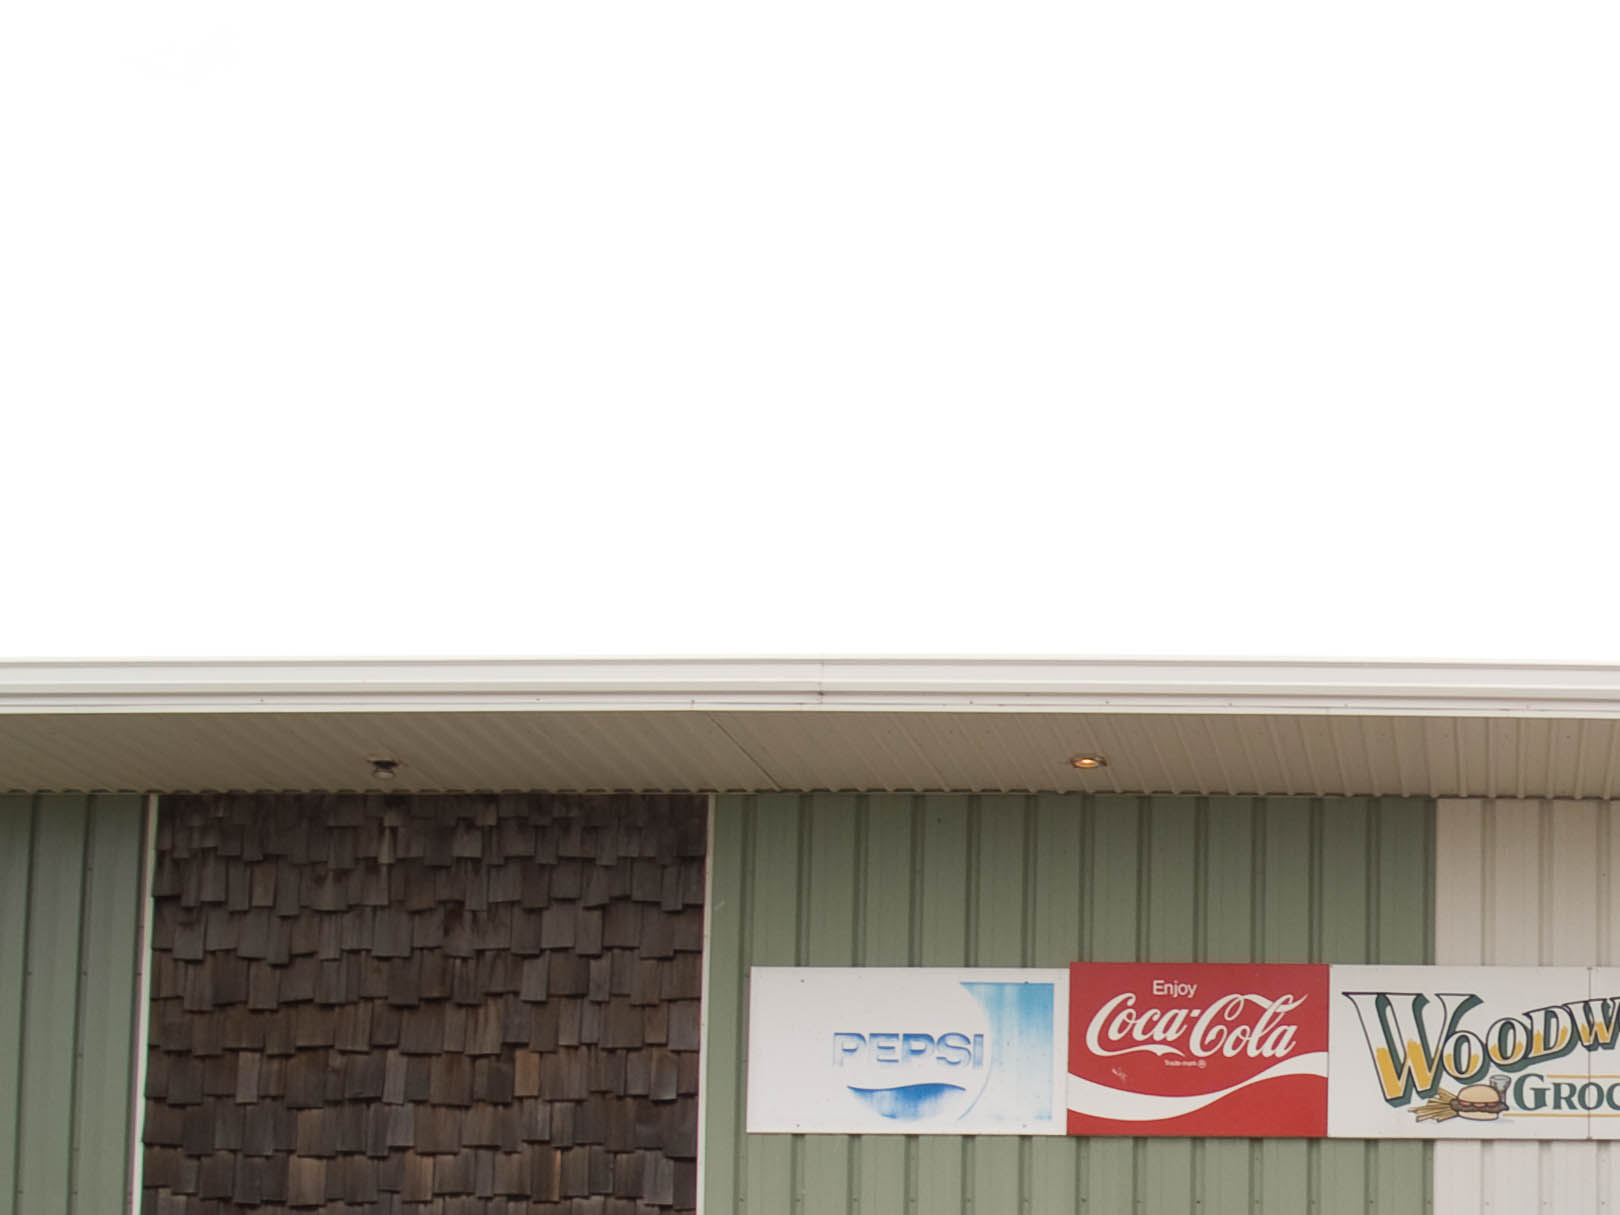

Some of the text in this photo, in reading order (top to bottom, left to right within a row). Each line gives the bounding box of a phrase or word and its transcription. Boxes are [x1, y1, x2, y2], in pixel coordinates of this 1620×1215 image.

[1152, 979, 1197, 999] Enjoy
[1086, 993, 1308, 1058] Coca-Cola
[833, 1032, 984, 1069] PEPSI
